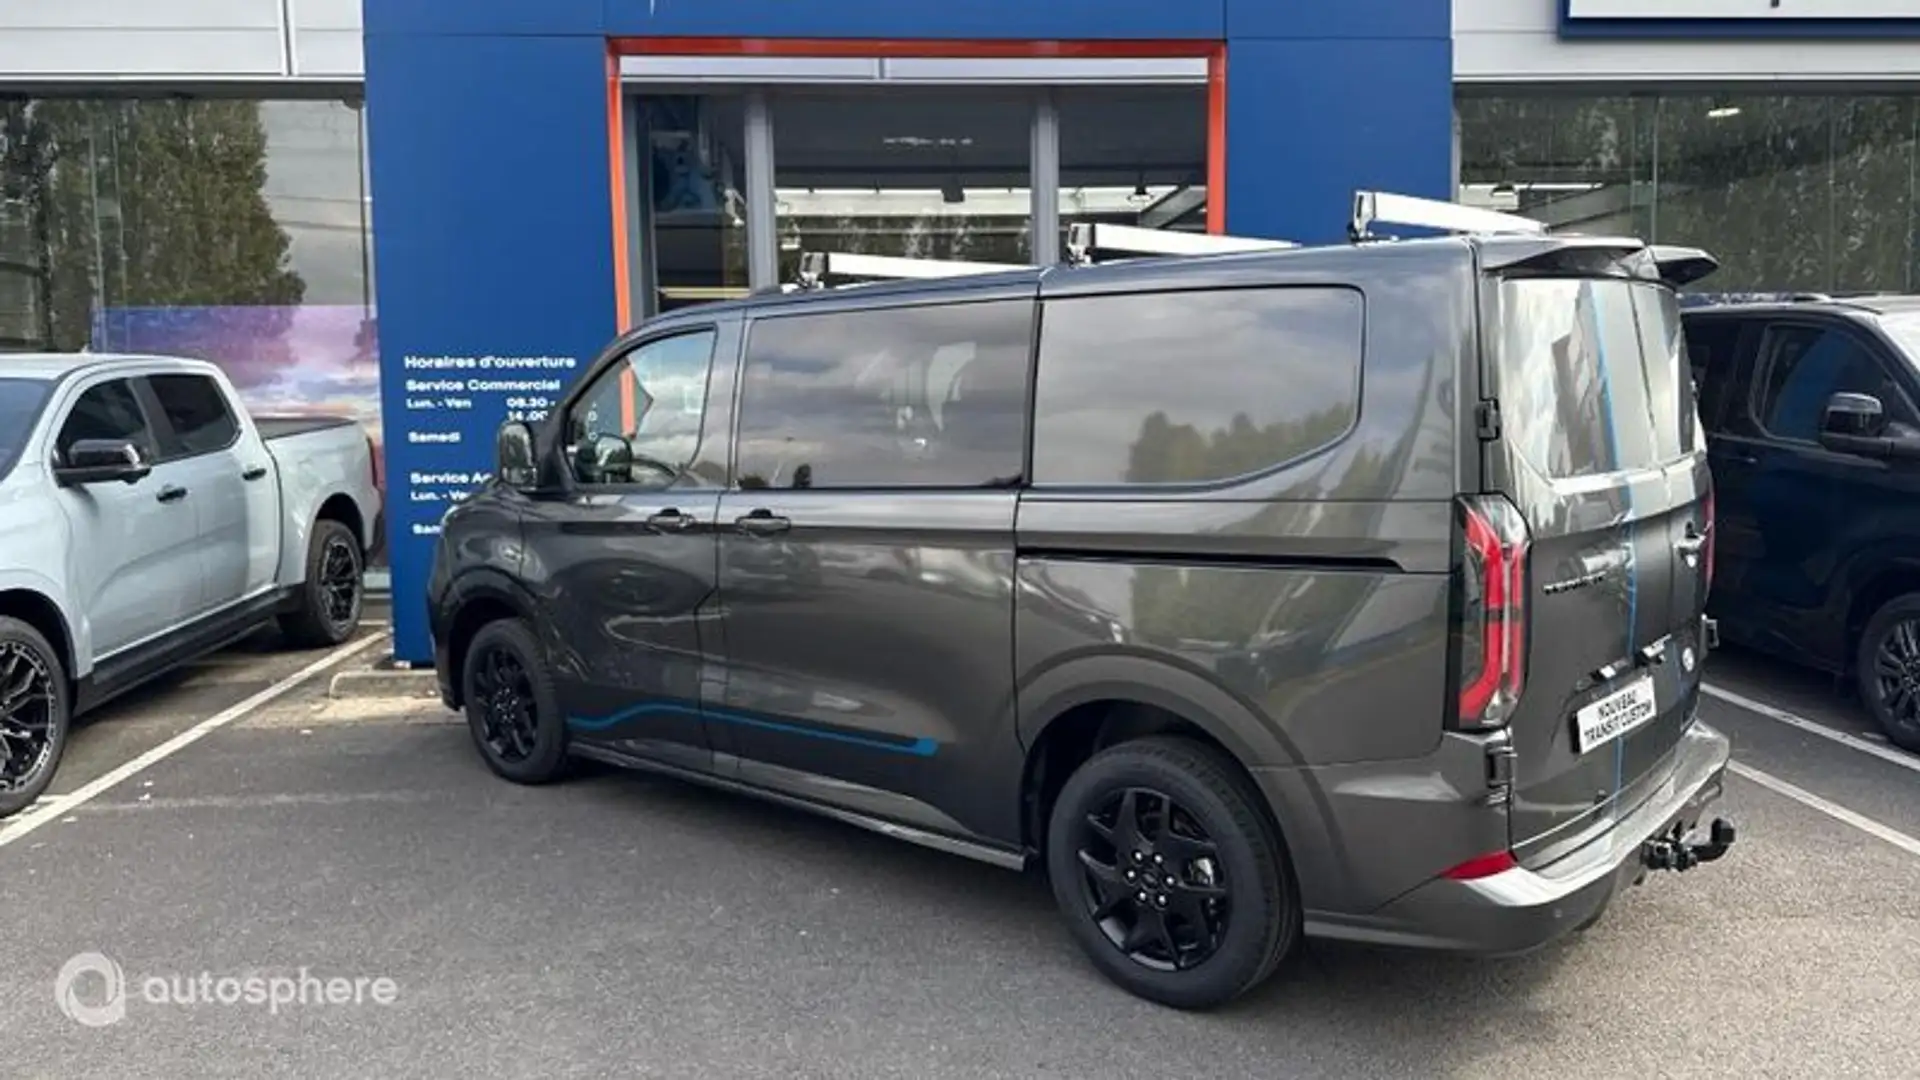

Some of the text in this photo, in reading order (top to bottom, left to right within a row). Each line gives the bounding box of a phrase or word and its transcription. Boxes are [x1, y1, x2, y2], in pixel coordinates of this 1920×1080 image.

[404, 356, 576, 369] Horaires d'ouverture
[406, 379, 561, 391] Service Commercial
[445, 398, 472, 409] Ven
[408, 432, 461, 443] Samedi
[410, 472, 469, 484] Service
[1584, 699, 1653, 742] TRANSIT CUSTOM
